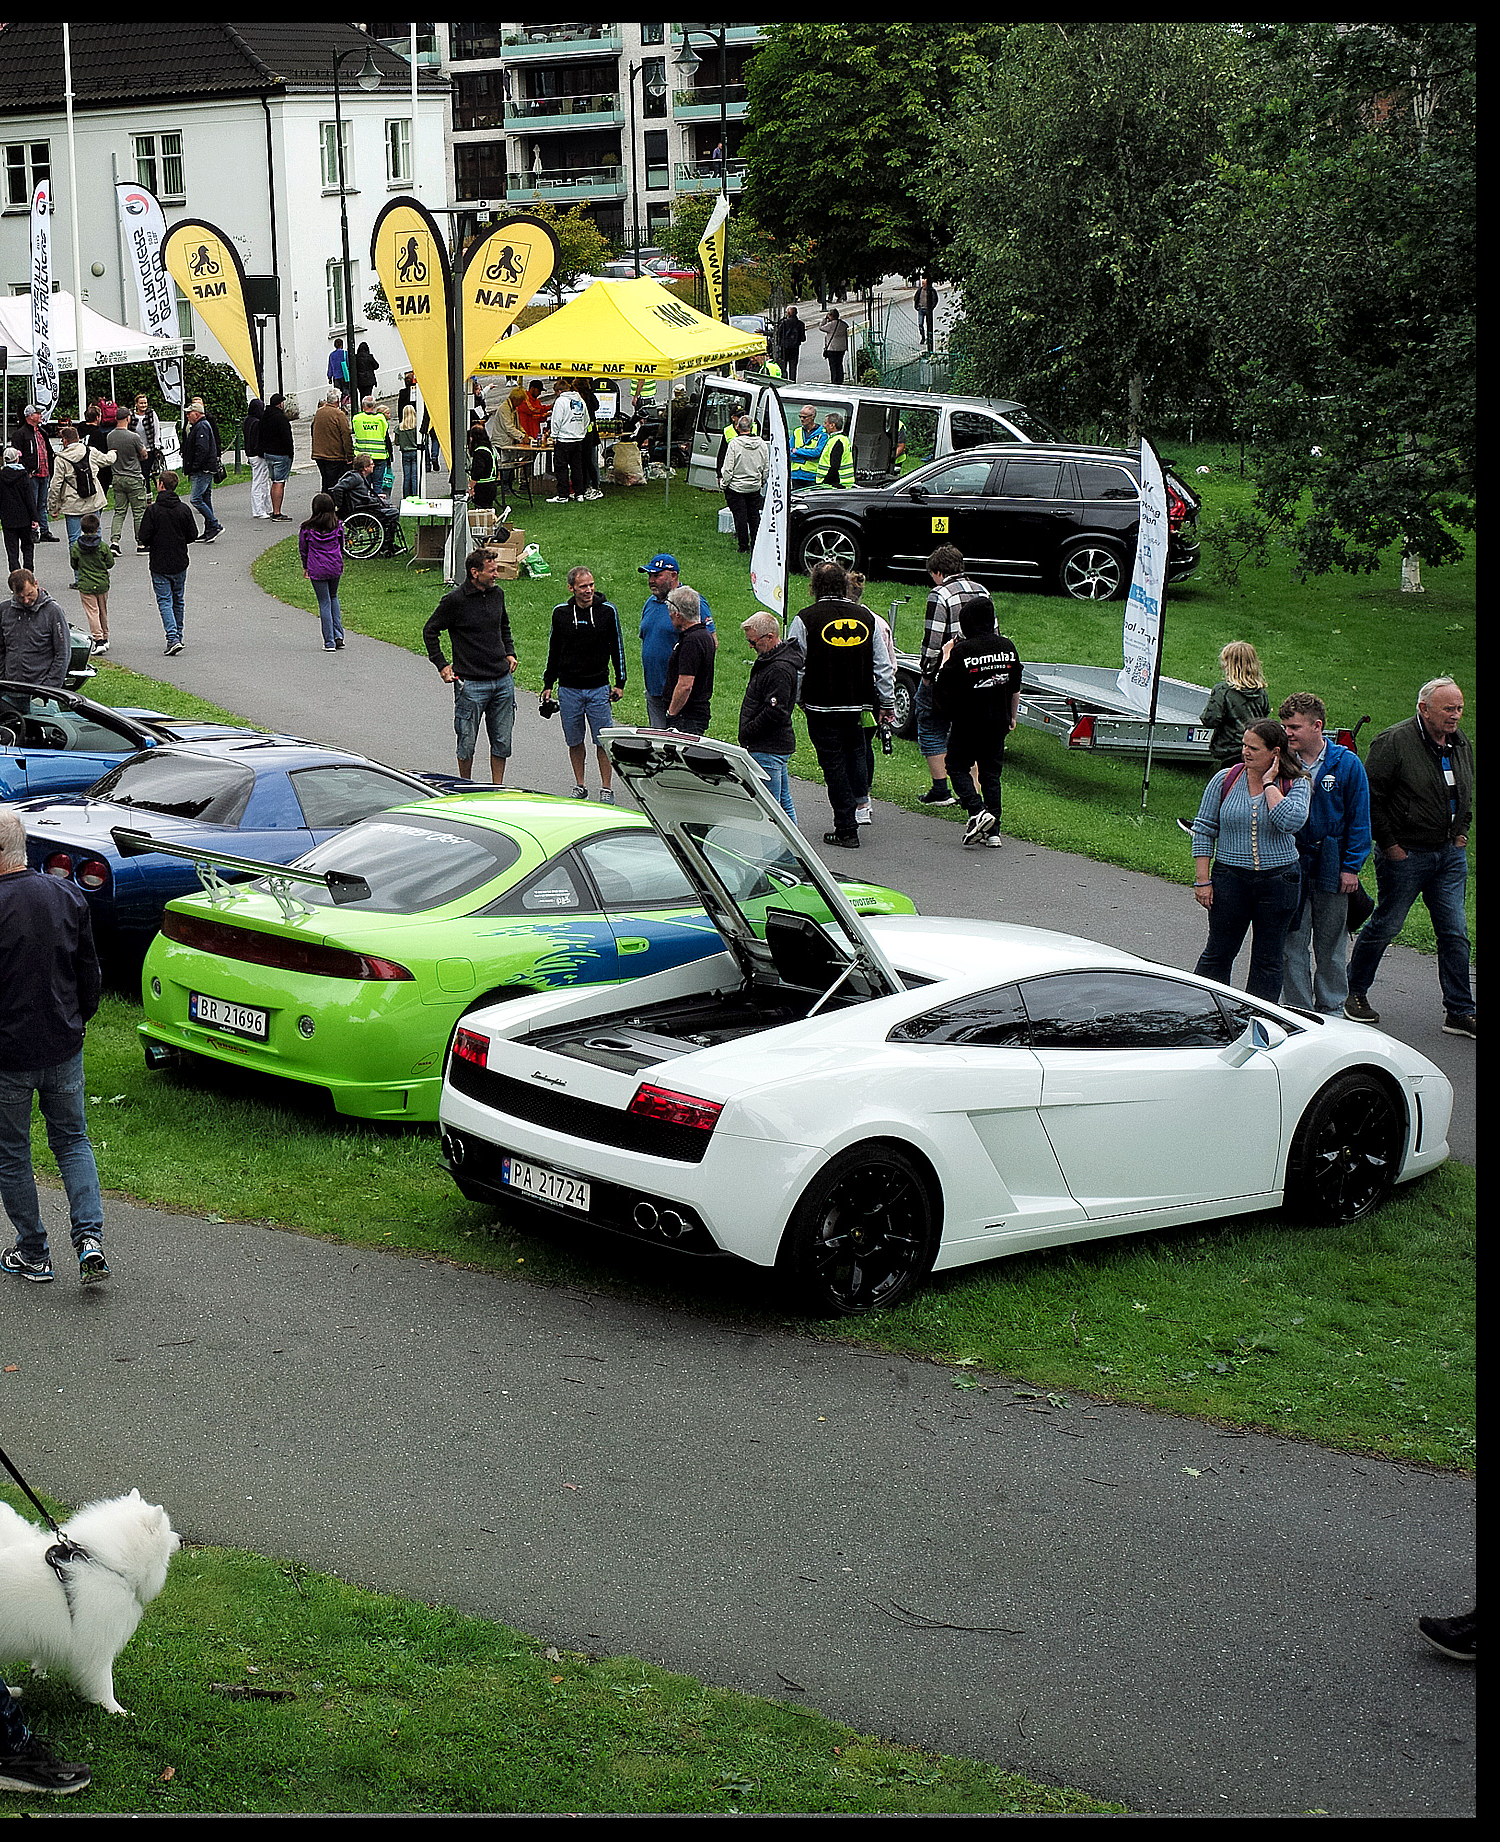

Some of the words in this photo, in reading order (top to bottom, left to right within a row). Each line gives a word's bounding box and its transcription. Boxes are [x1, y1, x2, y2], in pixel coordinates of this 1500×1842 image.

[474, 288, 519, 309] NAF
[479, 361, 501, 370] NAF
[509, 361, 532, 370] NAF
[540, 362, 562, 371] NAF
[571, 363, 594, 372] NAF
[602, 363, 626, 373] NAF
[634, 364, 658, 374] NAF
[1196, 729, 1209, 741] TZ
[201, 998, 218, 1020] BR
[223, 1005, 263, 1032] 21696
[514, 1163, 534, 1189] PA
[538, 1172, 586, 1206] 21724
